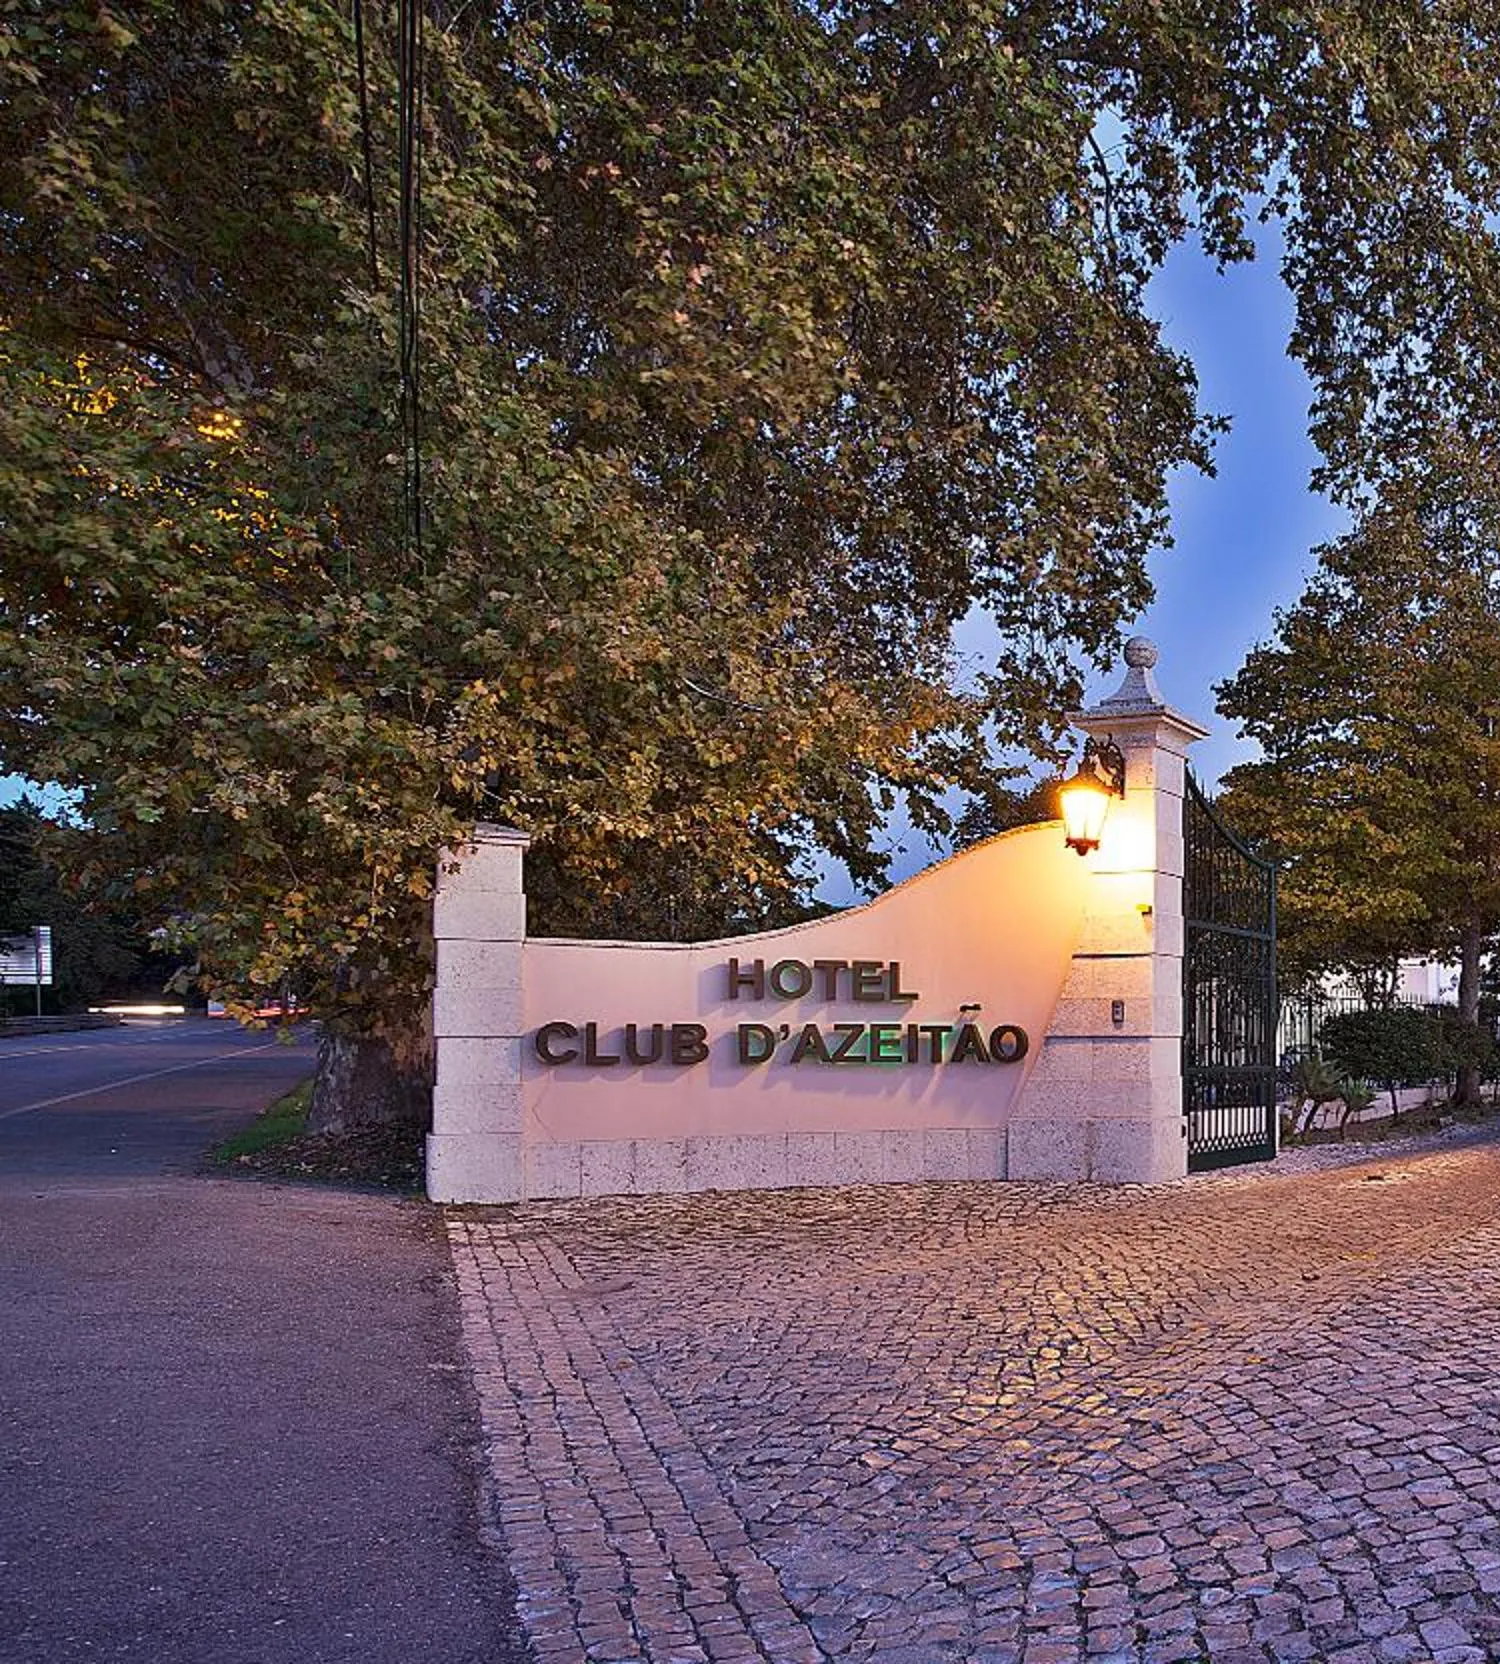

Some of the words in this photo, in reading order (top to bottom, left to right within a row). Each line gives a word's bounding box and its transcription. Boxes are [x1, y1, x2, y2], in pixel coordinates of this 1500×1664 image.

[727, 957, 919, 1001] HOTEL
[534, 1021, 710, 1066] CLUB
[737, 1003, 1030, 1066] D'AZEITÃO
